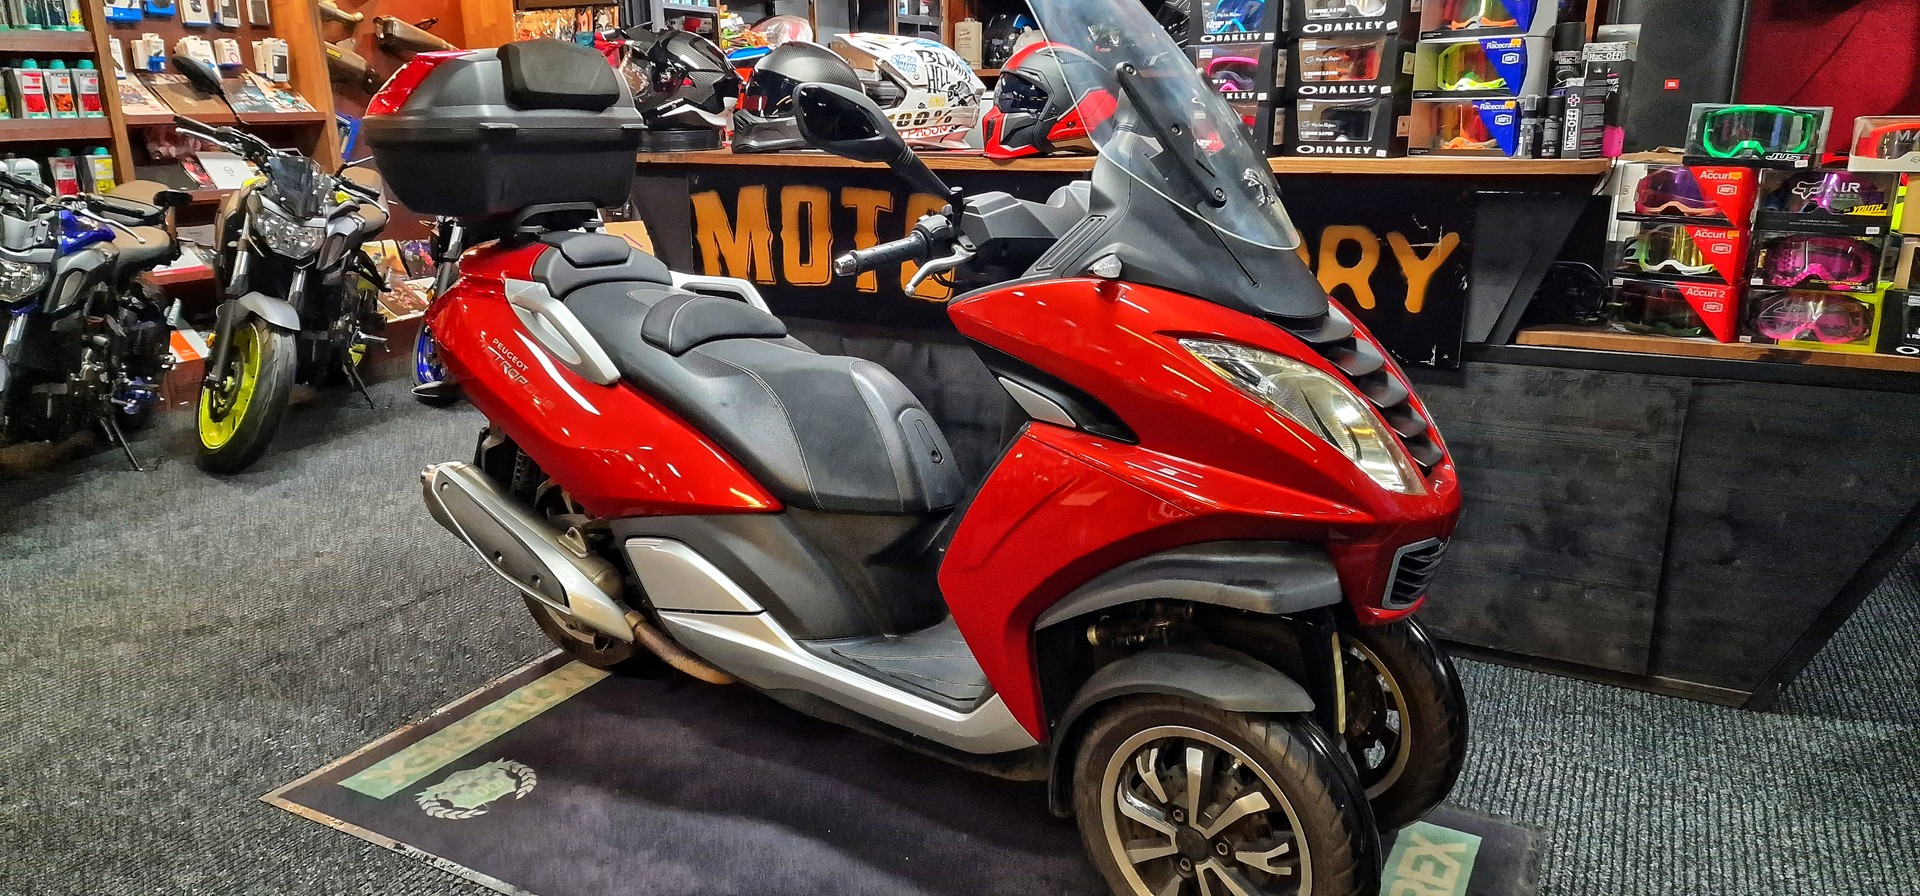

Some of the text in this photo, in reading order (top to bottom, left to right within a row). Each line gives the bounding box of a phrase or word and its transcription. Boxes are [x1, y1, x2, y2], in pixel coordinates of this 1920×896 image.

[1324, 20, 1384, 32] OAKLEY
[1216, 33, 1261, 42] OAKLEY
[1588, 52, 1621, 60] Muc-Off
[924, 64, 951, 94] HELL
[1319, 85, 1377, 94] OAKLEY
[1226, 92, 1255, 100] KLEY
[1566, 109, 1577, 149] Muc-Off
[1316, 146, 1373, 154] OAKLEY
[1853, 204, 1883, 213] YOUTH
[691, 185, 1461, 313] MOTO RY
[1718, 290, 1726, 299] 2
[492, 338, 529, 372] PEUGEOT
